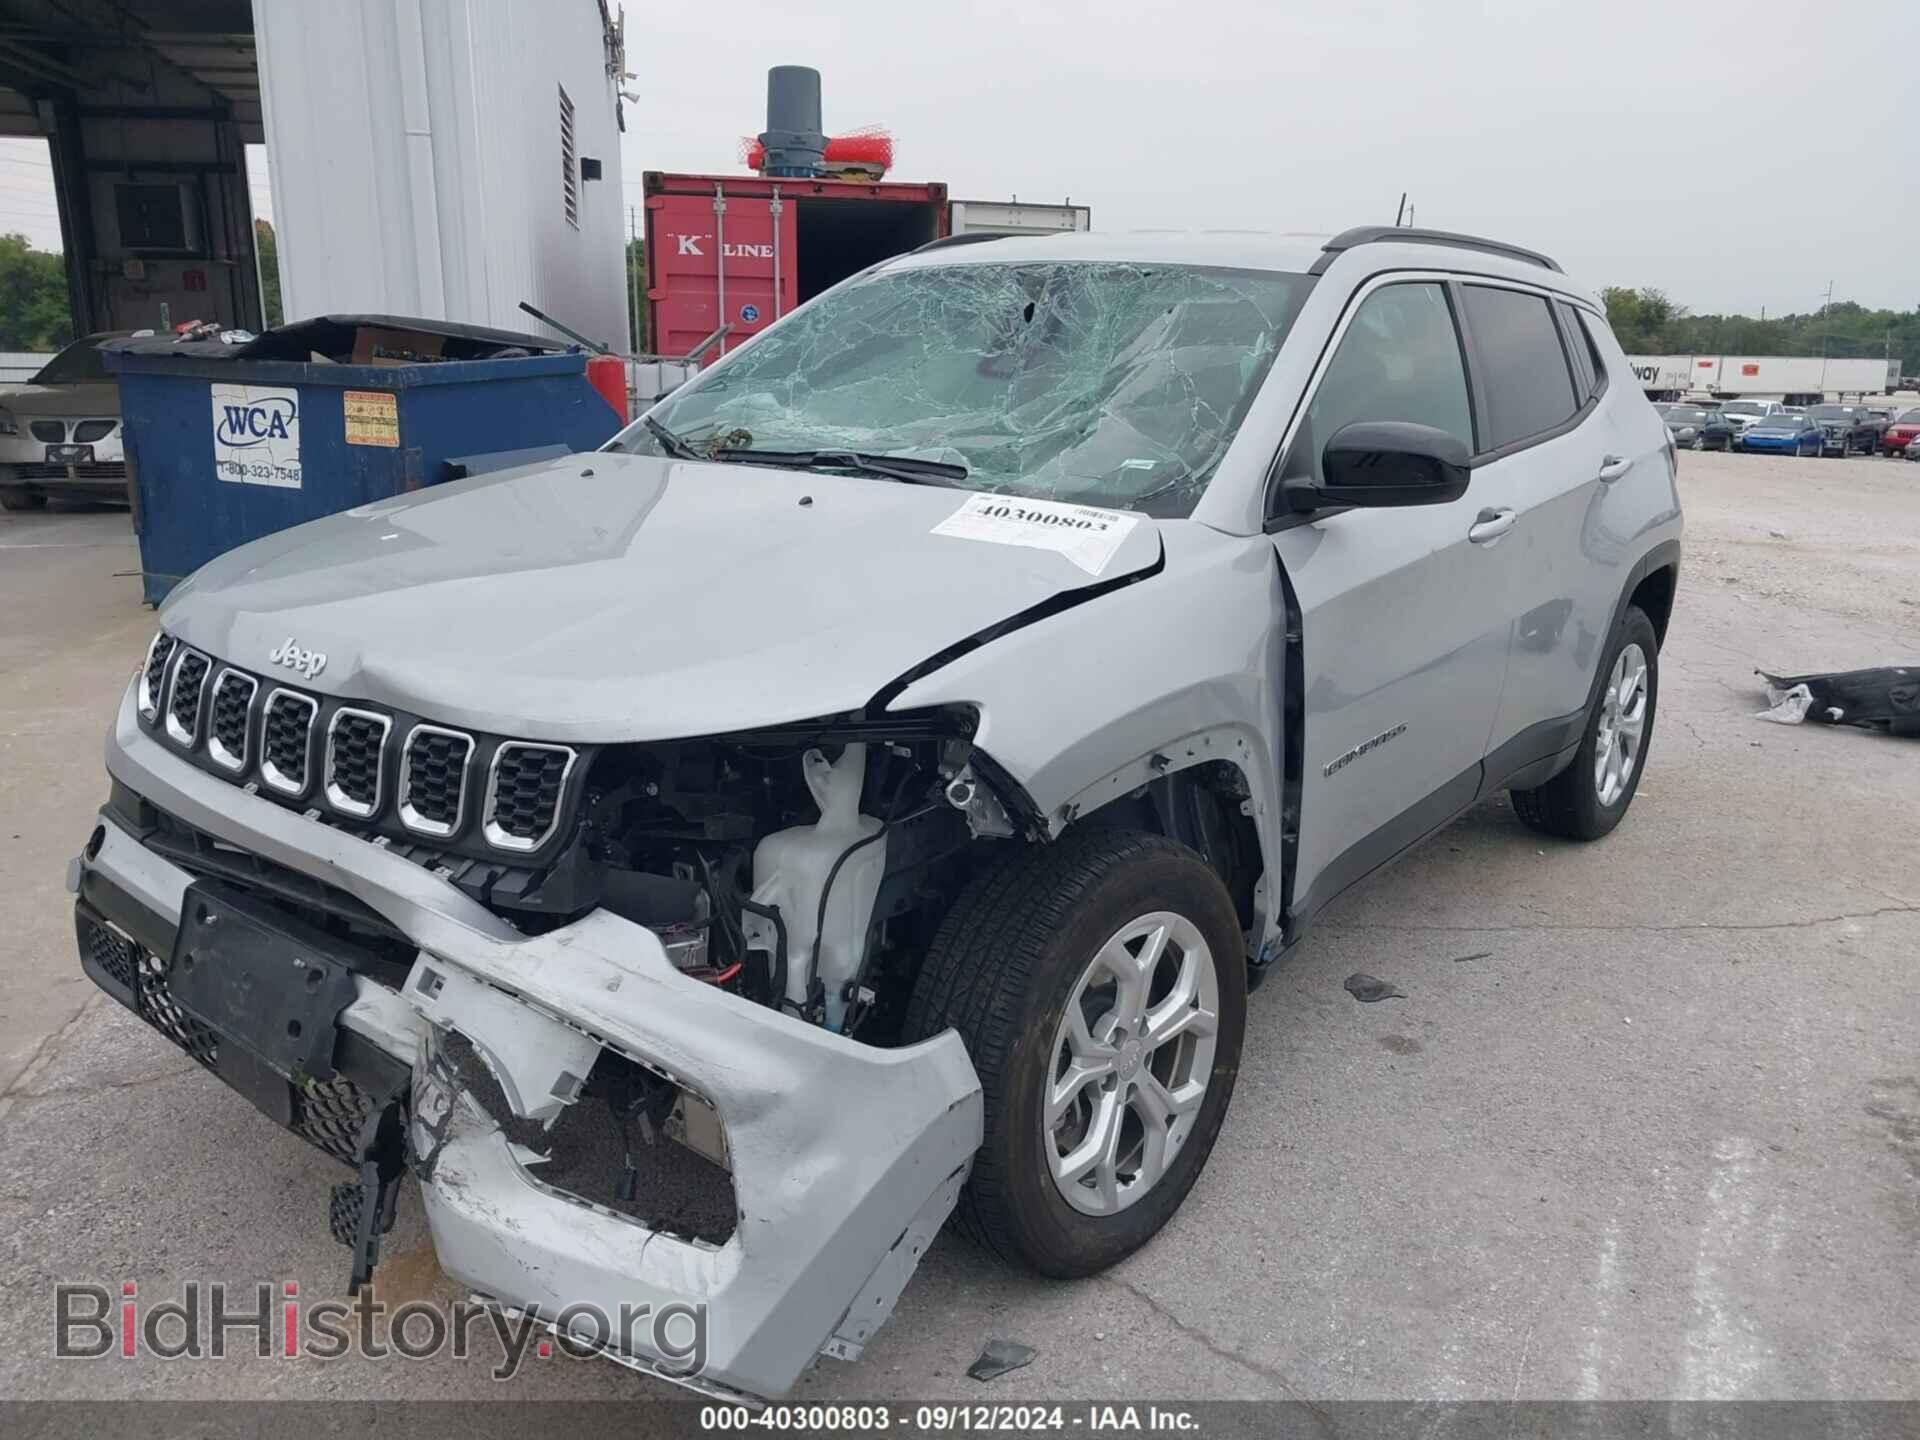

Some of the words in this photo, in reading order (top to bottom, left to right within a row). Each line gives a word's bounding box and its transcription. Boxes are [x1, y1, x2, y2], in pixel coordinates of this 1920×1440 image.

[724, 244, 774, 257] LINE
[1630, 362, 1660, 384] way
[223, 405, 289, 439] WCA
[219, 465, 300, 481] 1-800-323-7548
[977, 505, 1108, 531] 40300803
[270, 637, 328, 681] Jeep
